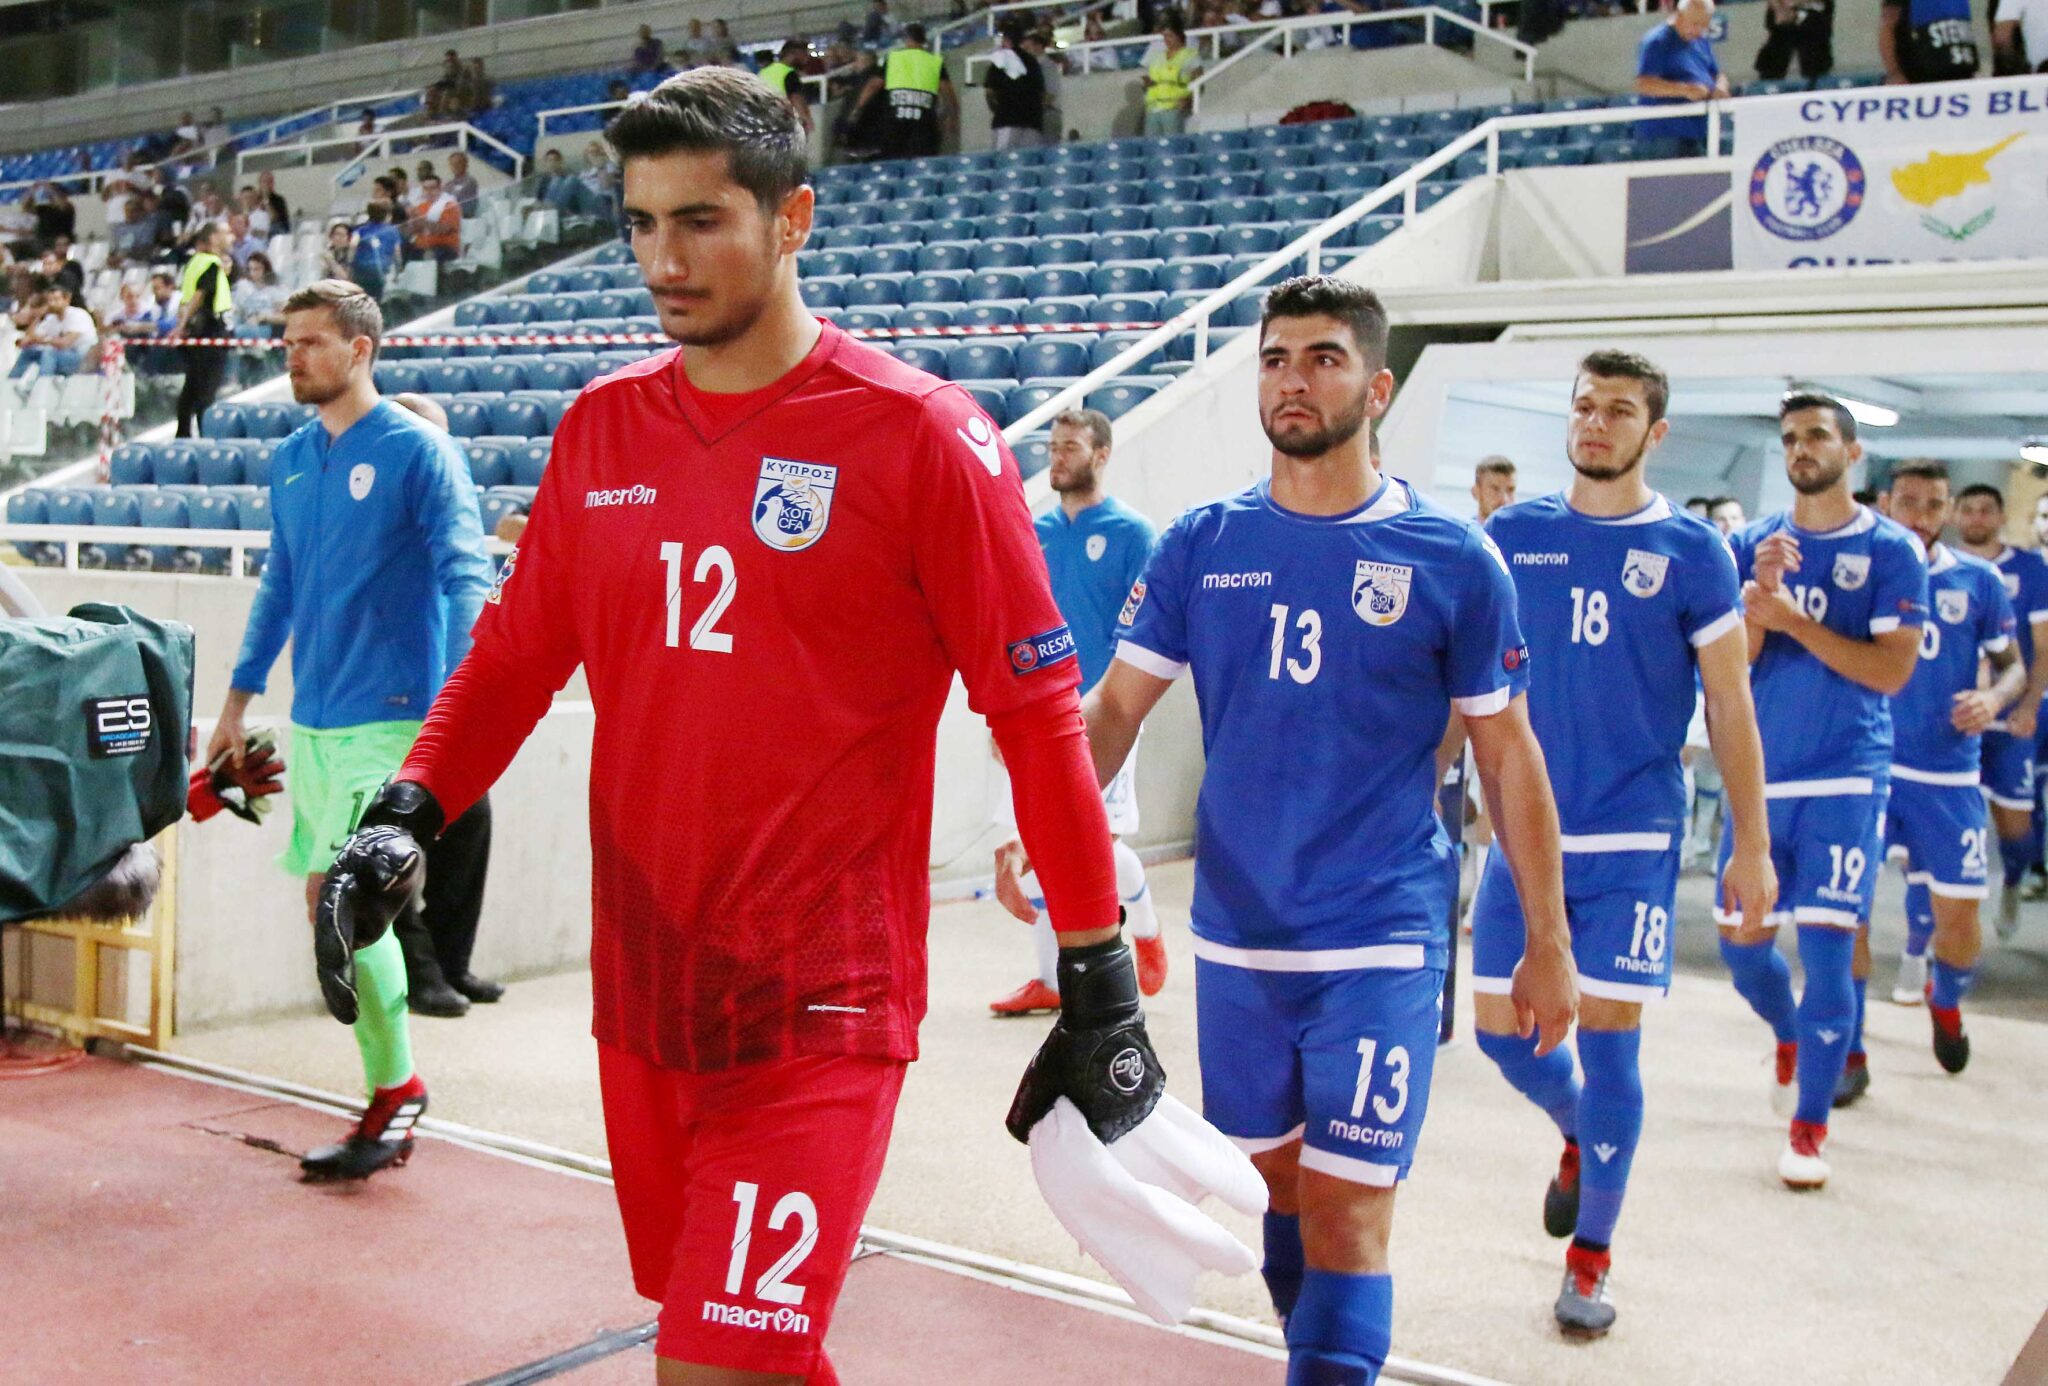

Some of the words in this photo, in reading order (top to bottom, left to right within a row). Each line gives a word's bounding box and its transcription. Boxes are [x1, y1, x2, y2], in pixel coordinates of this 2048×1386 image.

[1801, 93, 1970, 122] CYPRUS
[1988, 87, 2048, 115] BL
[766, 462, 833, 480] ΚΥΠΡΟΣ
[585, 484, 657, 508] macron
[778, 517, 805, 531] CFA
[1513, 552, 1569, 566] macron
[660, 541, 738, 654] 12
[1203, 571, 1273, 589] macron
[1570, 586, 1610, 646] 18
[1269, 603, 1322, 685] 13
[1918, 620, 1941, 660] 0
[97, 698, 151, 732] ES
[1829, 844, 1866, 893] 19
[1630, 901, 1668, 962] 18
[1350, 1037, 1410, 1125] 13
[1328, 1119, 1404, 1149] macron
[725, 1180, 820, 1306] 12
[701, 1300, 811, 1334] macron
